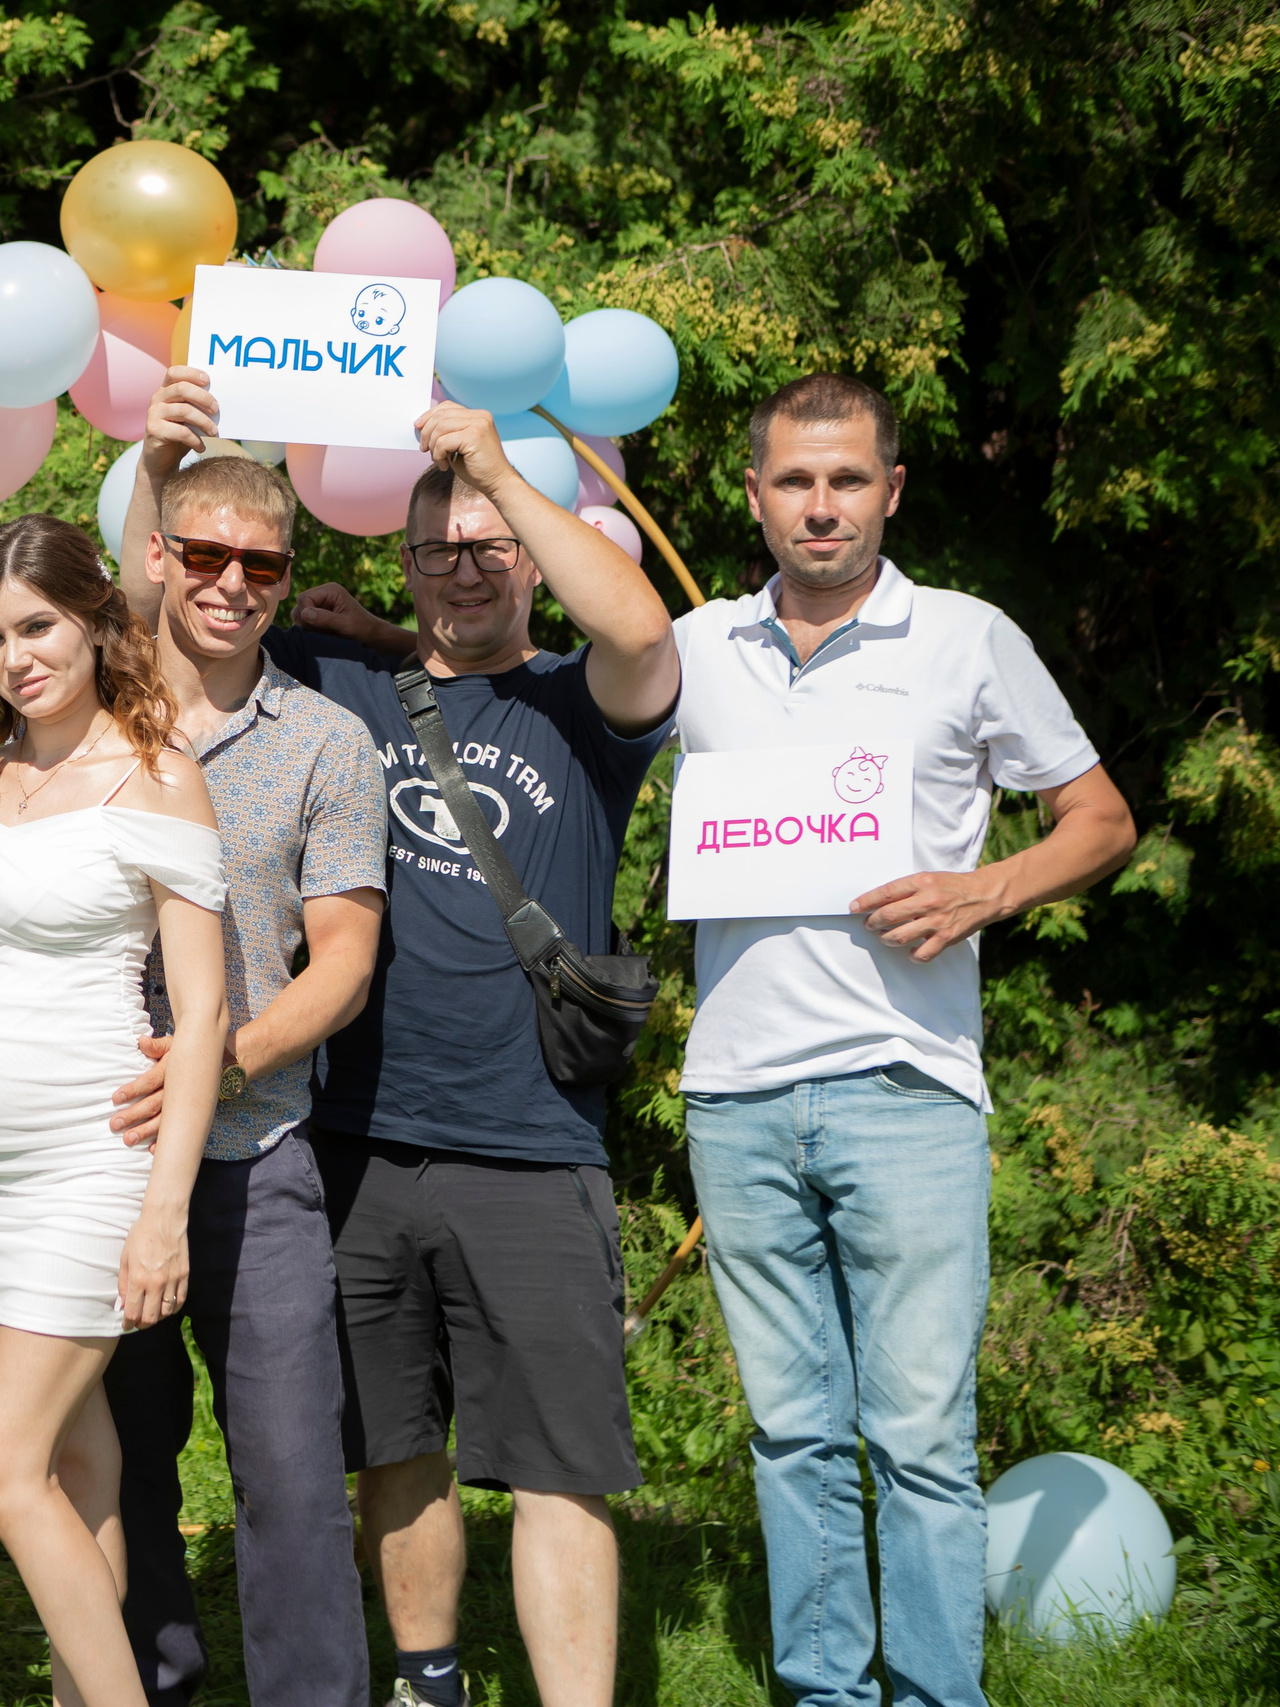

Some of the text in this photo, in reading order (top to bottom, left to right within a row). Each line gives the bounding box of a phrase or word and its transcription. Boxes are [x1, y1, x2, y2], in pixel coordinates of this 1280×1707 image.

[208, 333, 407, 377] МАЛЬЧИК
[401, 741, 501, 769] TLOR
[505, 754, 555, 815] TRM
[696, 811, 879, 854] ДЕВОЧКА
[417, 856, 461, 877] SINCE
[466, 867, 488, 885] 19
